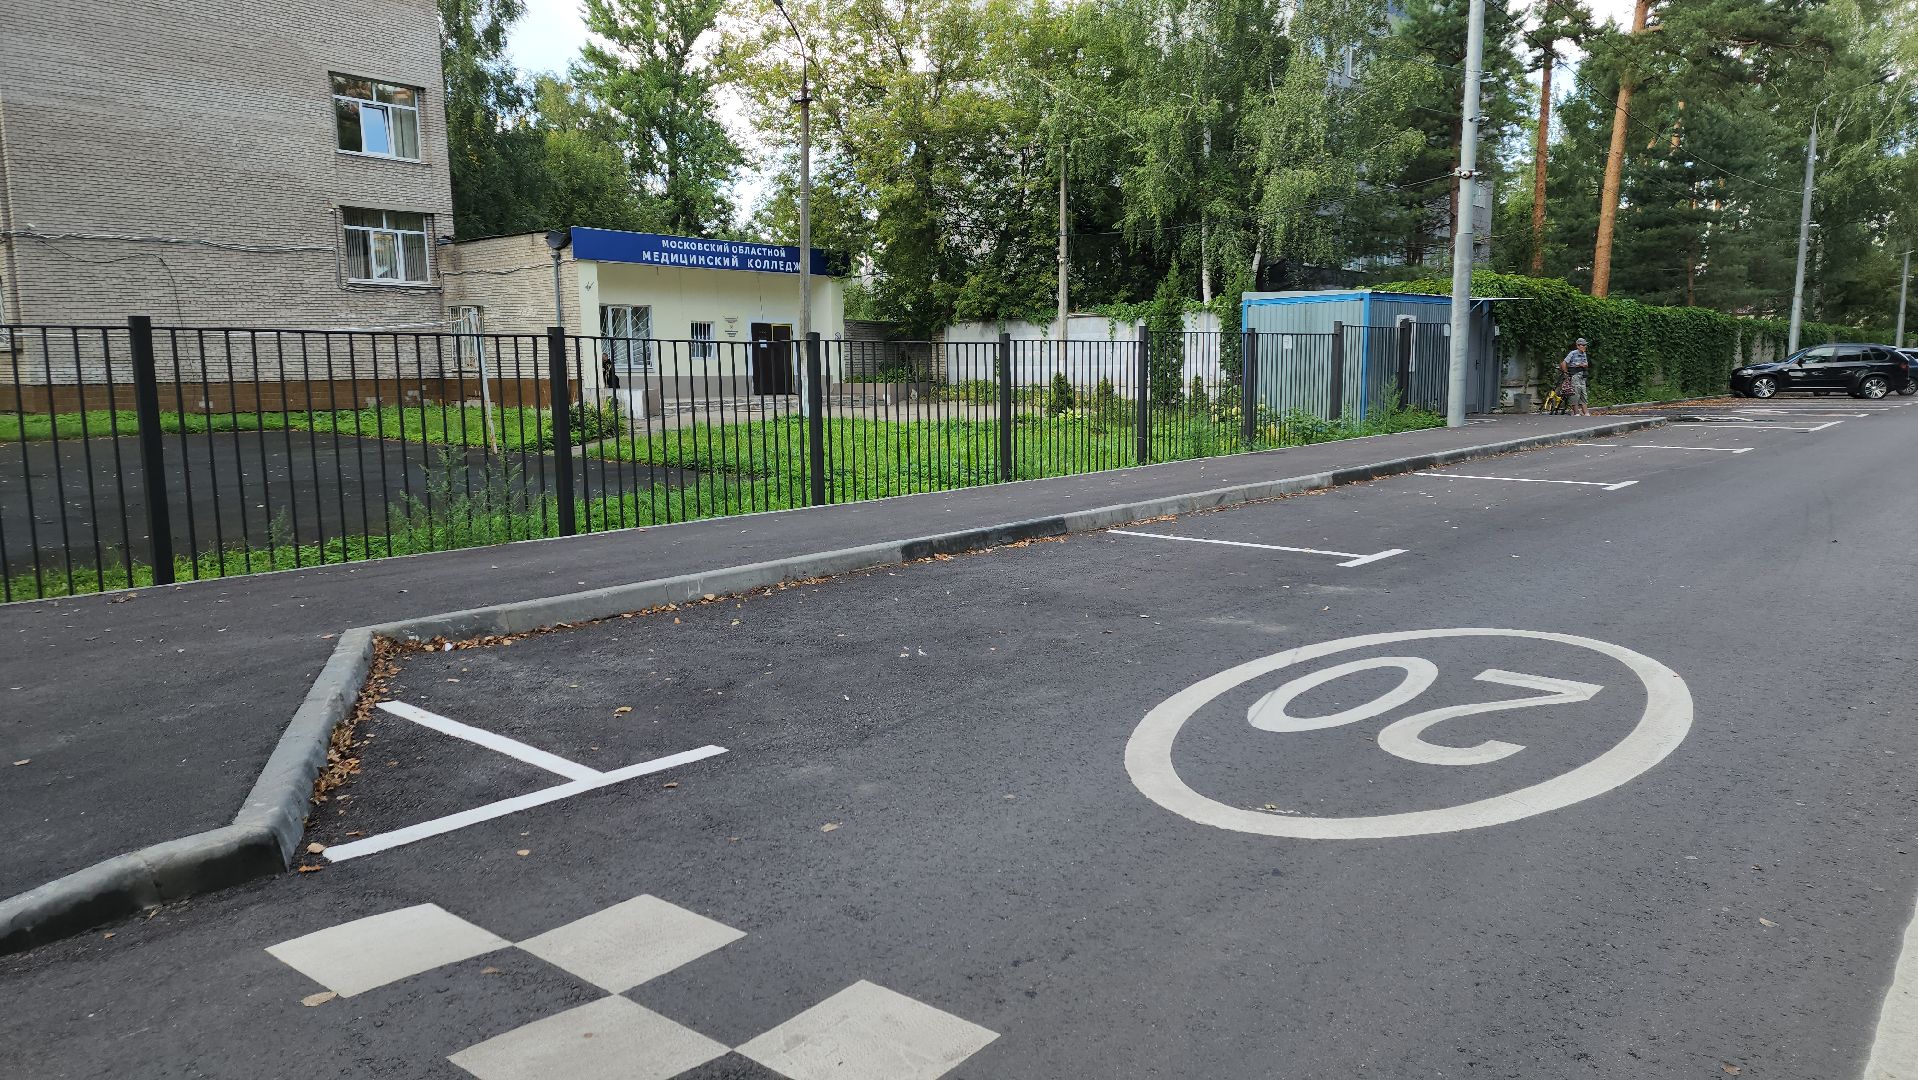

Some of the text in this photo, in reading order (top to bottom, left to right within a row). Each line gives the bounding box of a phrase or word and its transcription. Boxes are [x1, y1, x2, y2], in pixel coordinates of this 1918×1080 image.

[662, 240, 785, 257] МОСКОВСКИЙ ОБЛАСТНОЙ
[642, 250, 739, 266] МЕДИЦИНСКИЙ
[1247, 656, 1604, 766] 20
